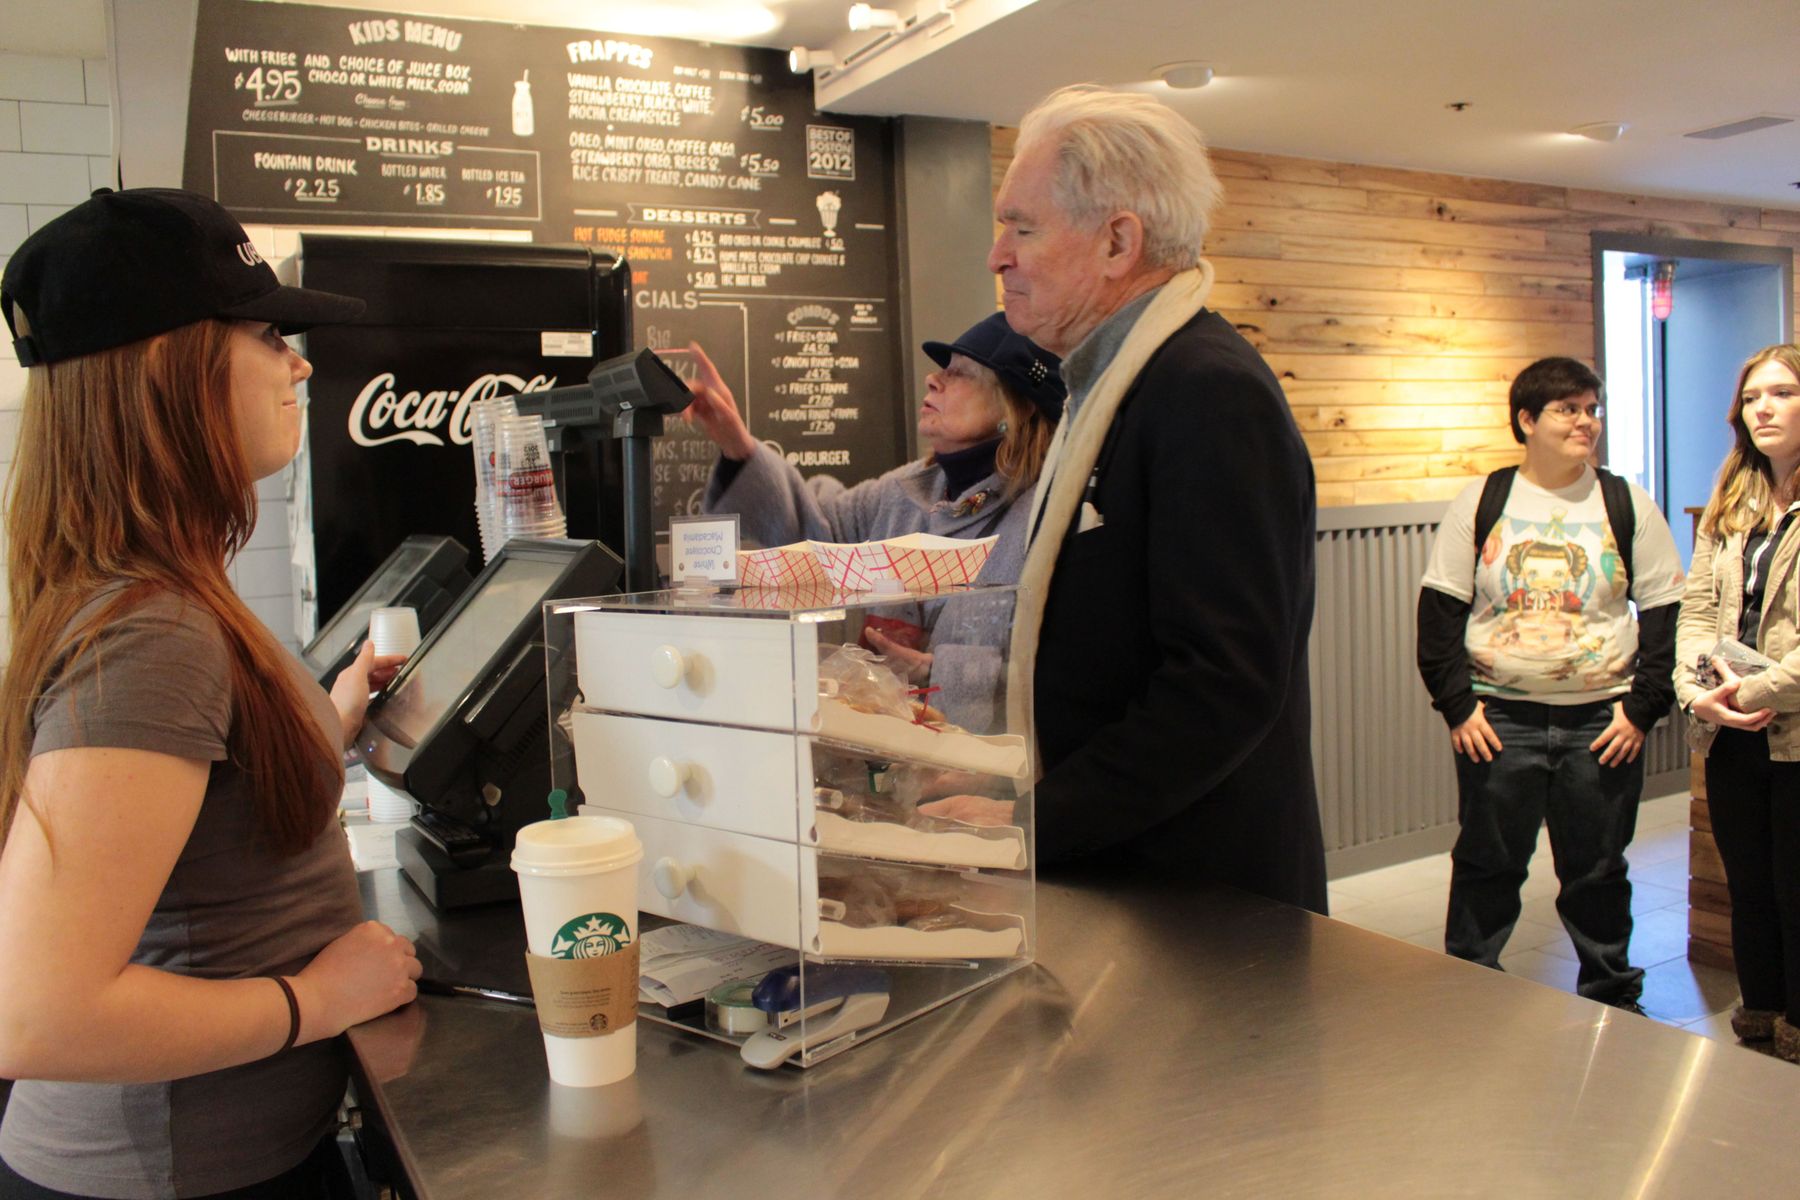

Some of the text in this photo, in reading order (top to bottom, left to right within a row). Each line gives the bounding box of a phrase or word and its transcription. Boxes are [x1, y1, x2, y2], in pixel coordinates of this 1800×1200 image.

[348, 19, 462, 52] KIDS MENU
[225, 48, 258, 63] WITH
[261, 50, 297, 66] FRIES
[304, 54, 330, 69] AND
[339, 55, 385, 73] CHOICE
[387, 59, 404, 74] OF
[406, 61, 442, 77] JUICE
[566, 39, 653, 69] FRAPPES
[234, 67, 302, 101] $4.95
[308, 69, 348, 84] CHOCO
[350, 72, 367, 86] OR
[368, 74, 404, 90] WHITE
[437, 79, 469, 94] SODA
[643, 96, 677, 112] BLACK
[242, 108, 314, 124] CHEESEBURGER
[319, 114, 336, 125] HOT
[337, 115, 354, 127] DOG
[359, 117, 396, 130] CHICKEN
[426, 122, 457, 134] GRILLED
[741, 106, 784, 127] $5.00
[604, 134, 635, 149] MINT
[667, 138, 707, 156] COFFEE
[809, 128, 851, 142] BEST OF
[365, 136, 453, 156] DRINKS
[810, 140, 851, 153] BOSTON
[254, 152, 359, 176] FOUNTAIN DRINK
[571, 149, 643, 167] STRAWBERRY
[740, 153, 780, 174] $5.50
[810, 152, 852, 171] 2012
[381, 163, 447, 179] BOTTLED WATER
[461, 168, 526, 184] BOTTLED ICE TEA
[572, 165, 599, 182] RICE
[602, 167, 641, 184] CRISPY
[685, 172, 726, 189] CANDY
[727, 176, 761, 192] CANE
[642, 208, 747, 225] DESSERTS
[574, 227, 594, 242] HOT
[596, 227, 627, 242] FUDGE
[758, 251, 794, 265] CHOCOLATE
[635, 290, 698, 310] CIALS
[679, 463, 708, 482] SPRE
